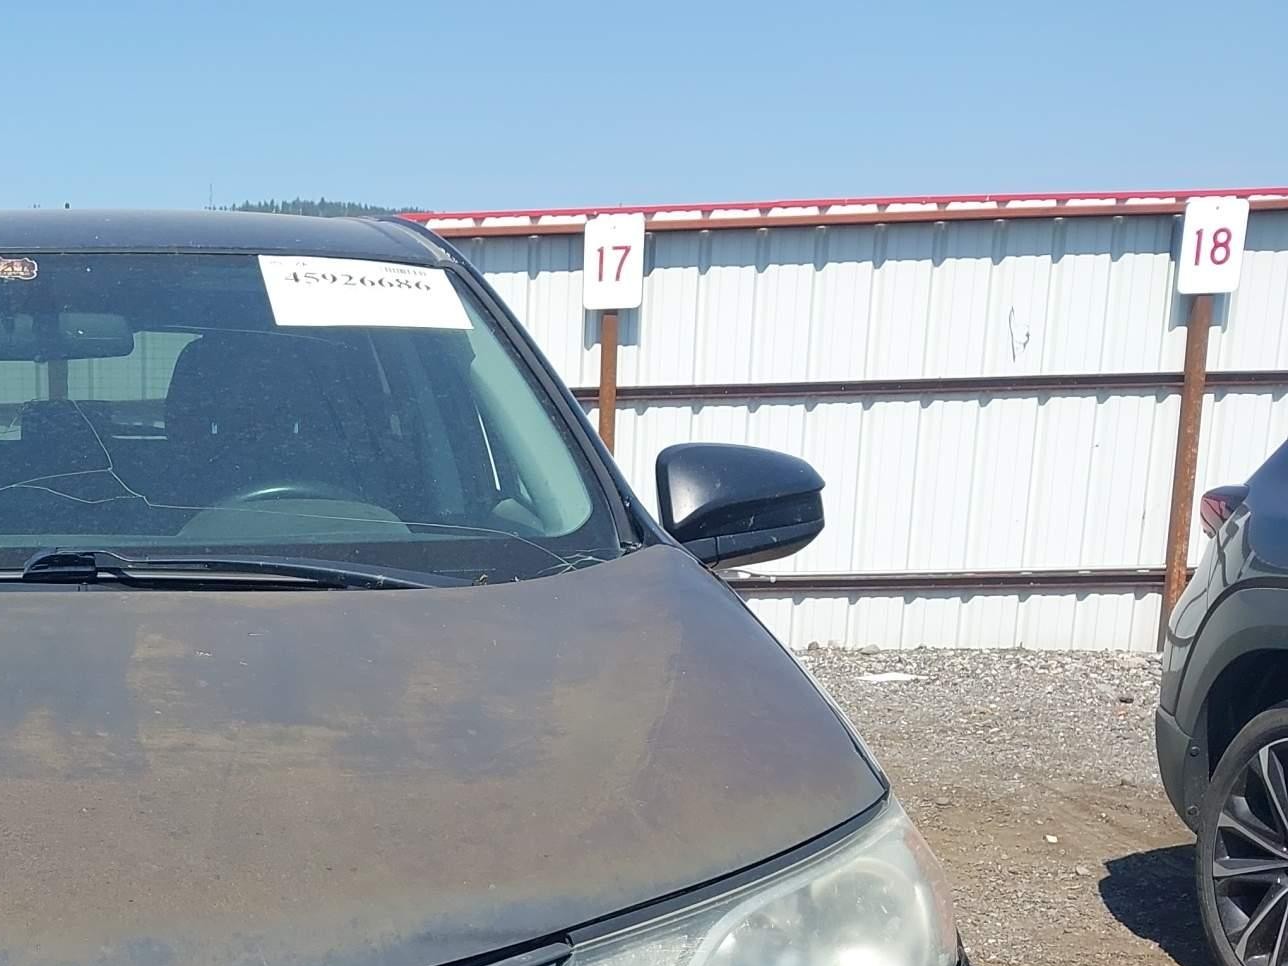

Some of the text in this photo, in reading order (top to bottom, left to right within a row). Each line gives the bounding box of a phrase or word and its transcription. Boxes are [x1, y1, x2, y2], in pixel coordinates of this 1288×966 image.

[595, 245, 632, 284] 17
[1193, 227, 1233, 266] 18
[284, 270, 432, 292] 45926686
